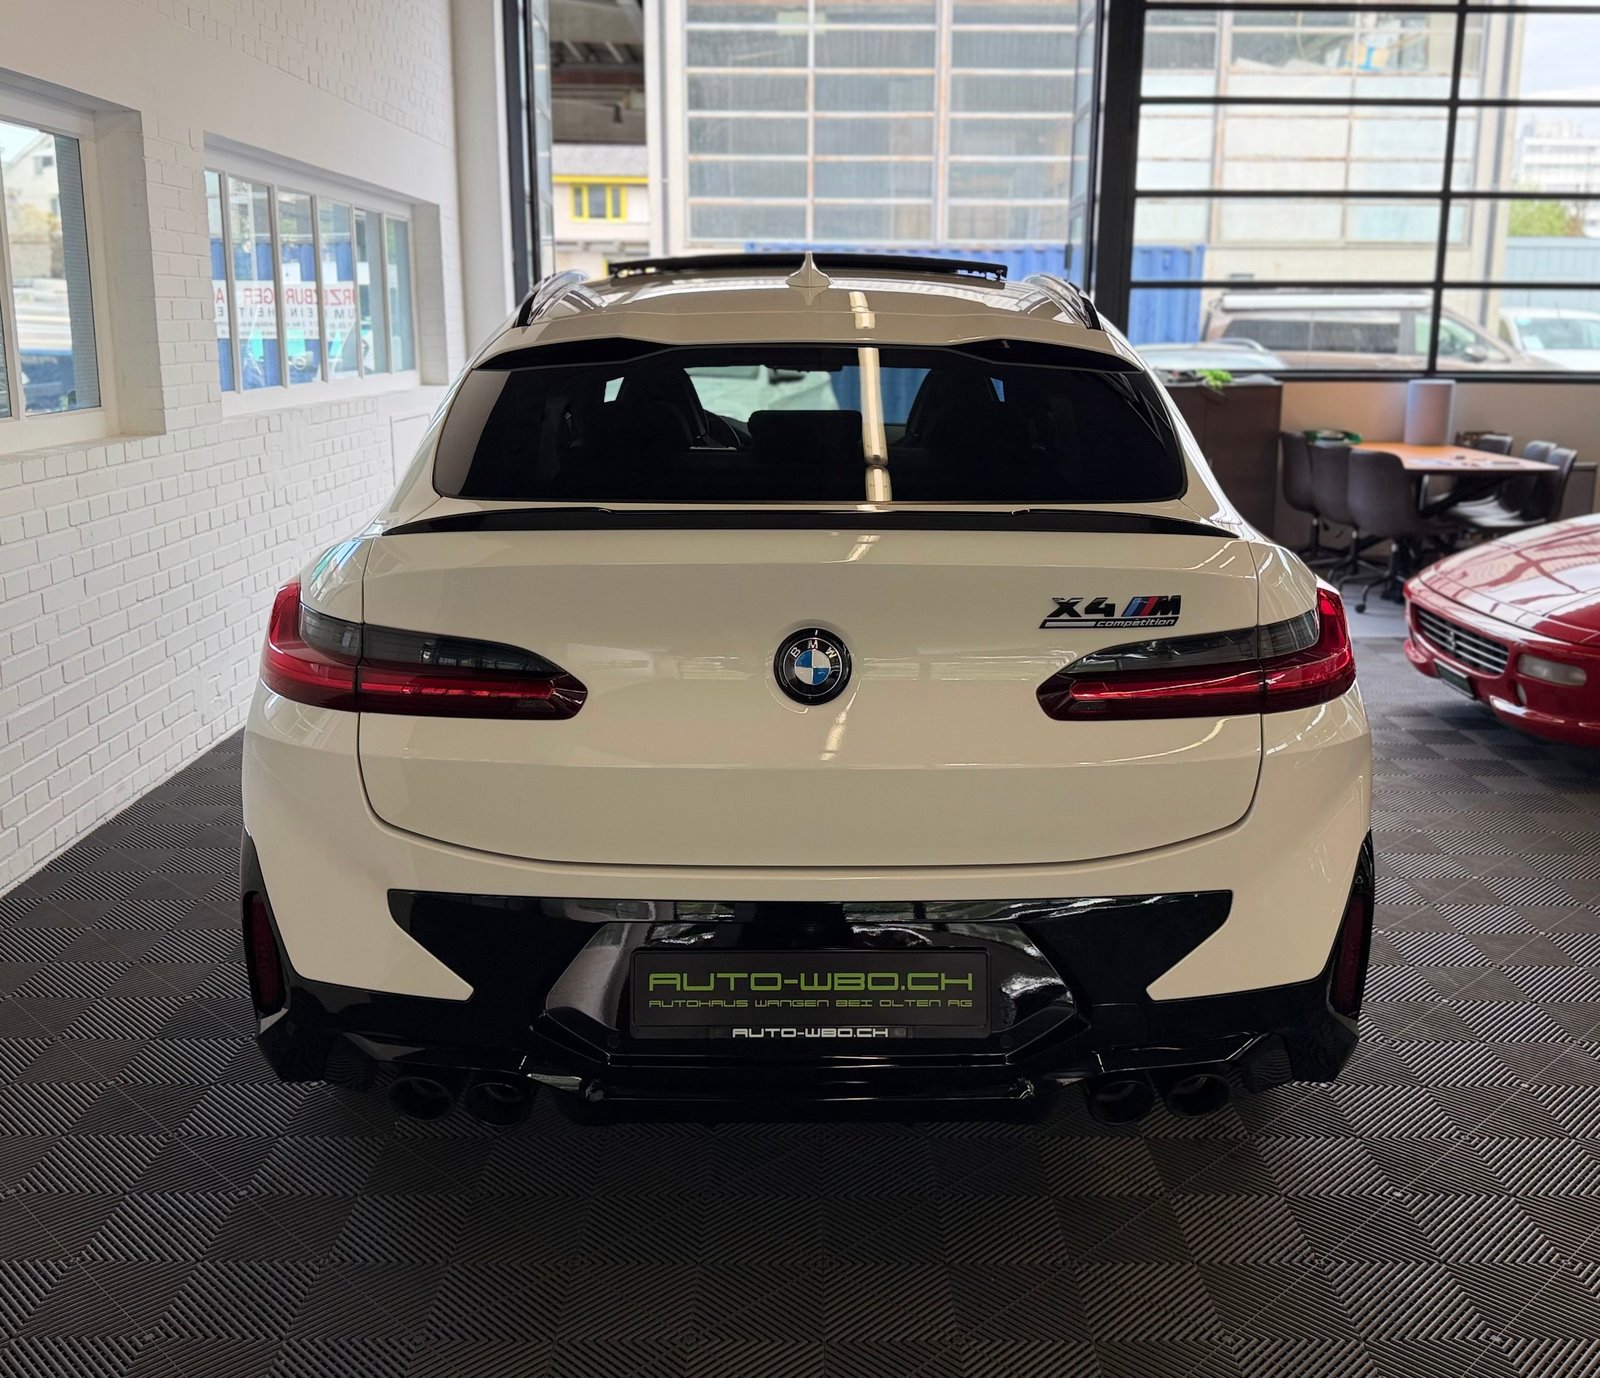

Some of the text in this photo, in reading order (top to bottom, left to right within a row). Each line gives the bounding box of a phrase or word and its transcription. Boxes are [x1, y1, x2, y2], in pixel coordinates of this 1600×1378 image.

[1046, 597, 1116, 618] X4
[1095, 617, 1176, 628] competition
[790, 639, 837, 658] BMW
[648, 972, 974, 992] AUTO-WBO.CH
[648, 999, 974, 1008] AUTOHAUS WANGEN BEI OLTEN AG
[731, 1027, 890, 1039] AUTO-WBO.CH
